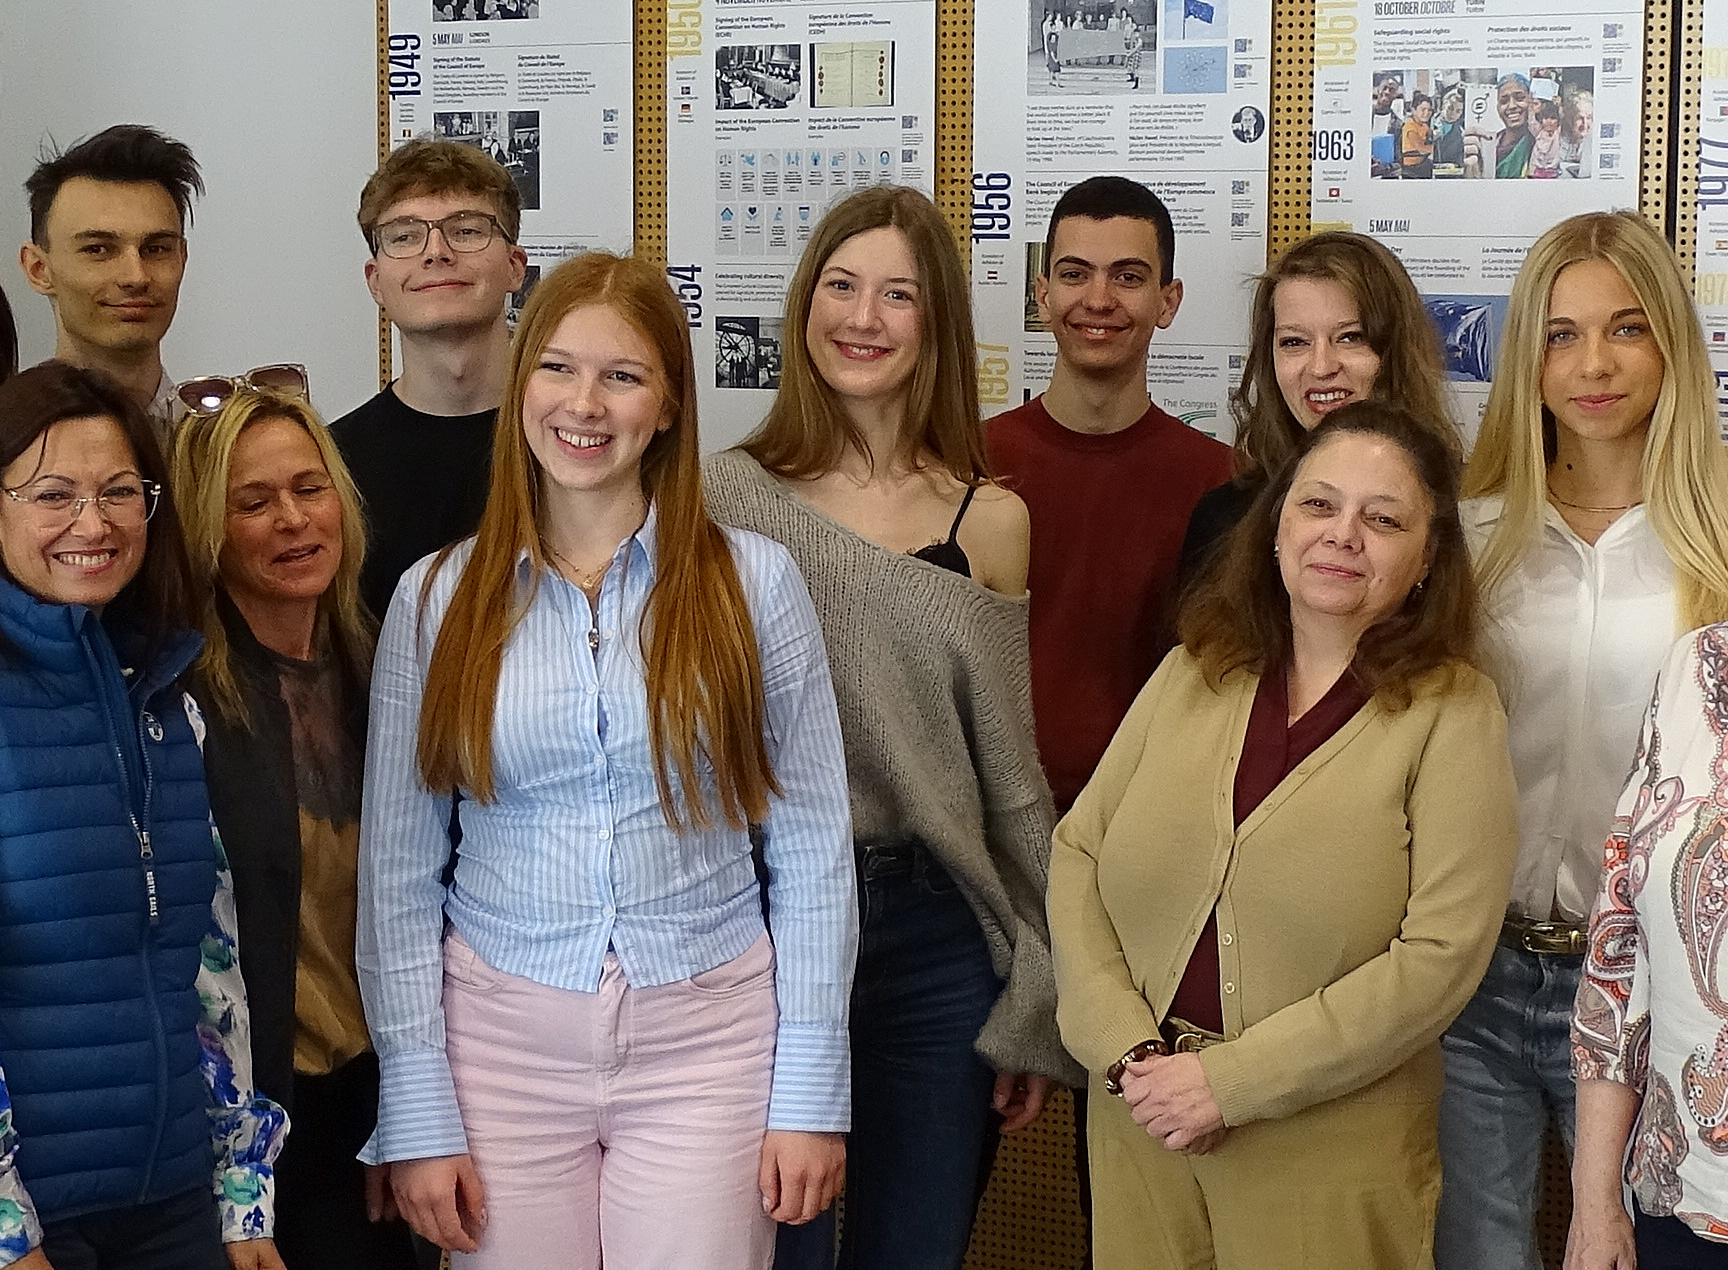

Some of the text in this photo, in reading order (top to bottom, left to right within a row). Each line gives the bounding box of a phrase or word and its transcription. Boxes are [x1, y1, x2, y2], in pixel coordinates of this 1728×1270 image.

[1384, 1, 1419, 16] OCTOBER
[1420, 0, 1456, 14] OCTOBRE
[437, 33, 450, 45] MAY
[388, 33, 421, 101] 1949
[1313, 129, 1354, 161] 1963
[973, 172, 1011, 245] 1956
[1369, 219, 1375, 233] 5
[1376, 219, 1392, 233] MAY
[1394, 219, 1410, 232] MAI
[1163, 399, 1218, 410] The Congress
